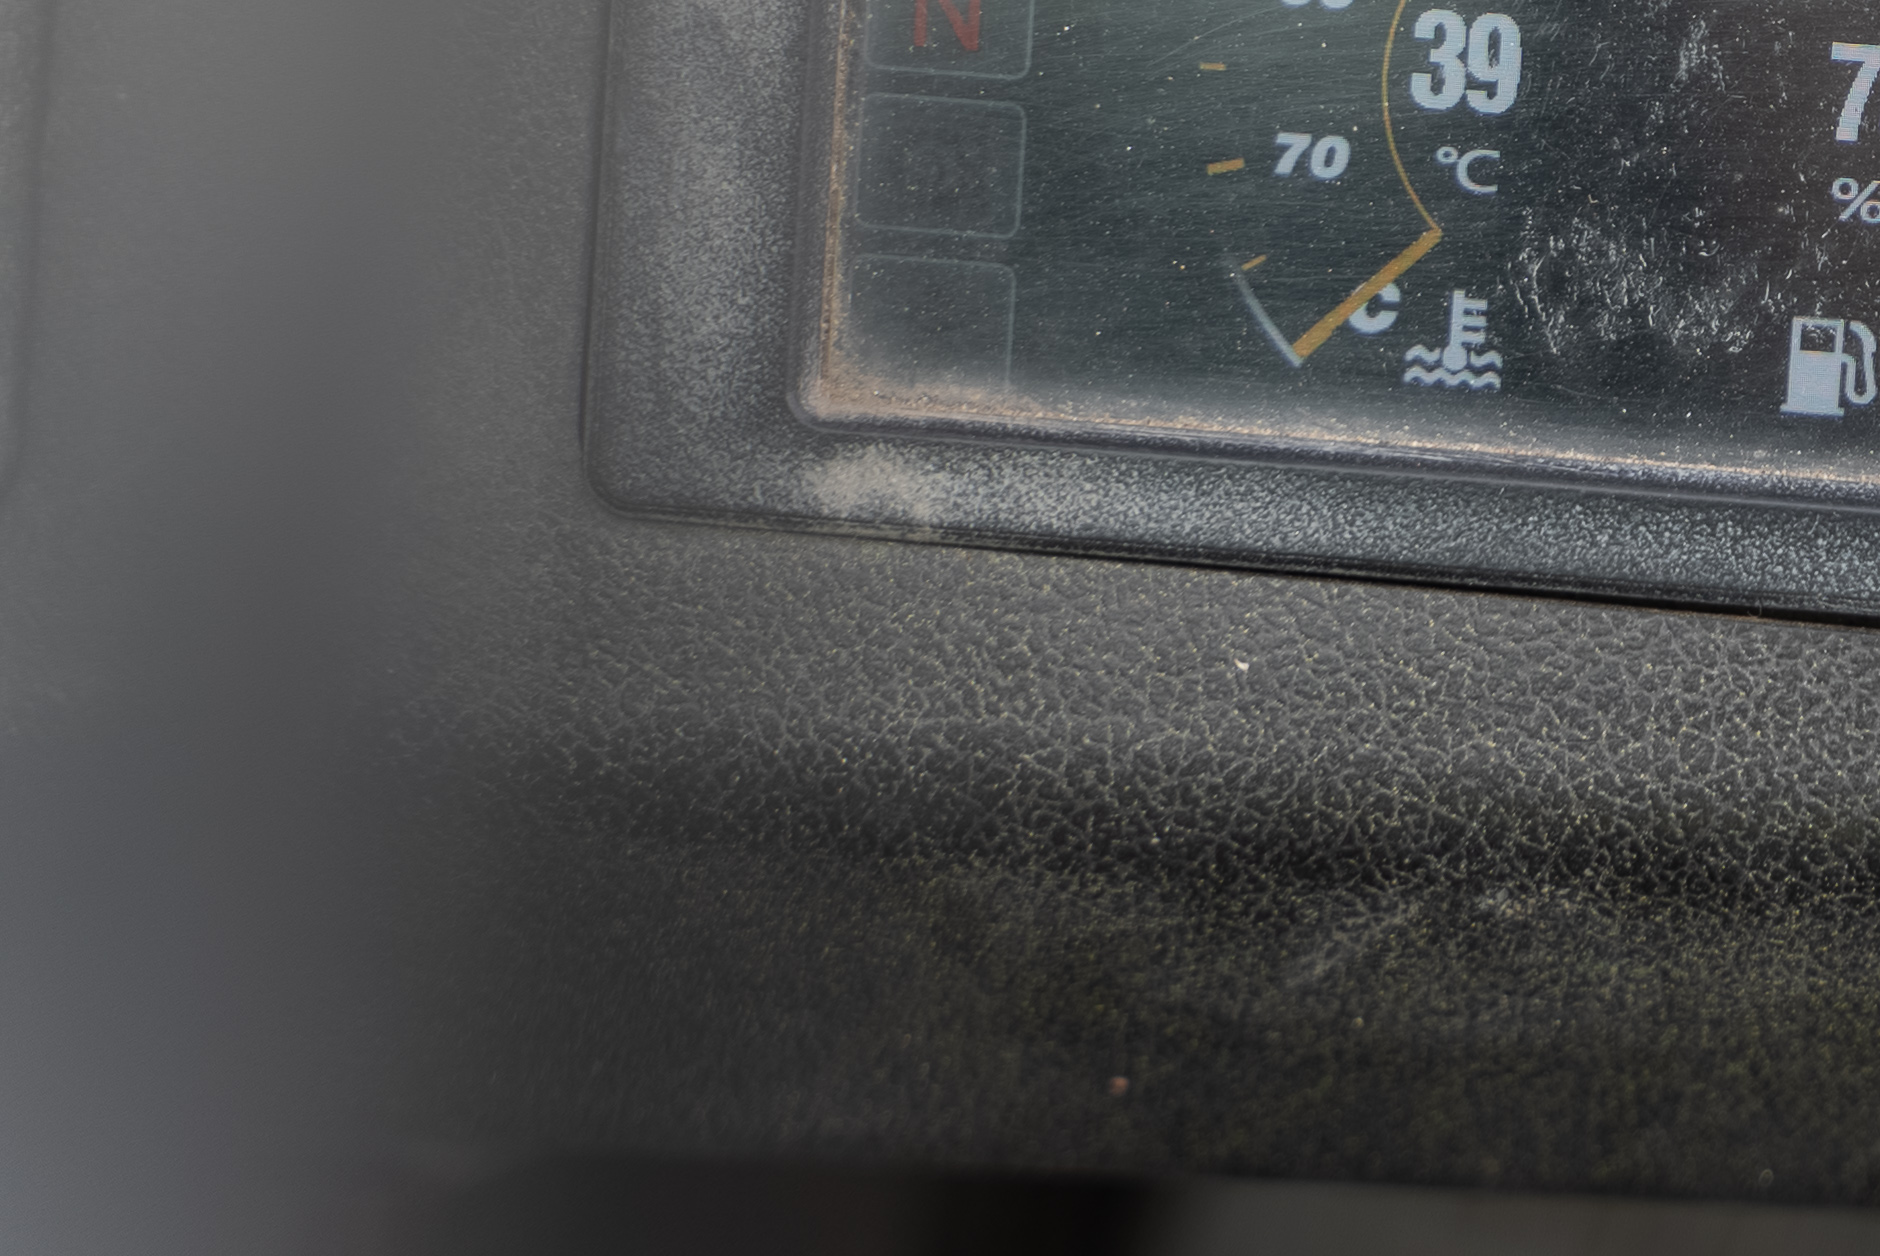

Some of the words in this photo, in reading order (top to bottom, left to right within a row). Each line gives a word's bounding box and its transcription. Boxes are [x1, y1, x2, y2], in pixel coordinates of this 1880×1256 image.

[1410, 8, 1522, 114] 39
[1273, 132, 1351, 179] 70
[1347, 281, 1401, 334] C
